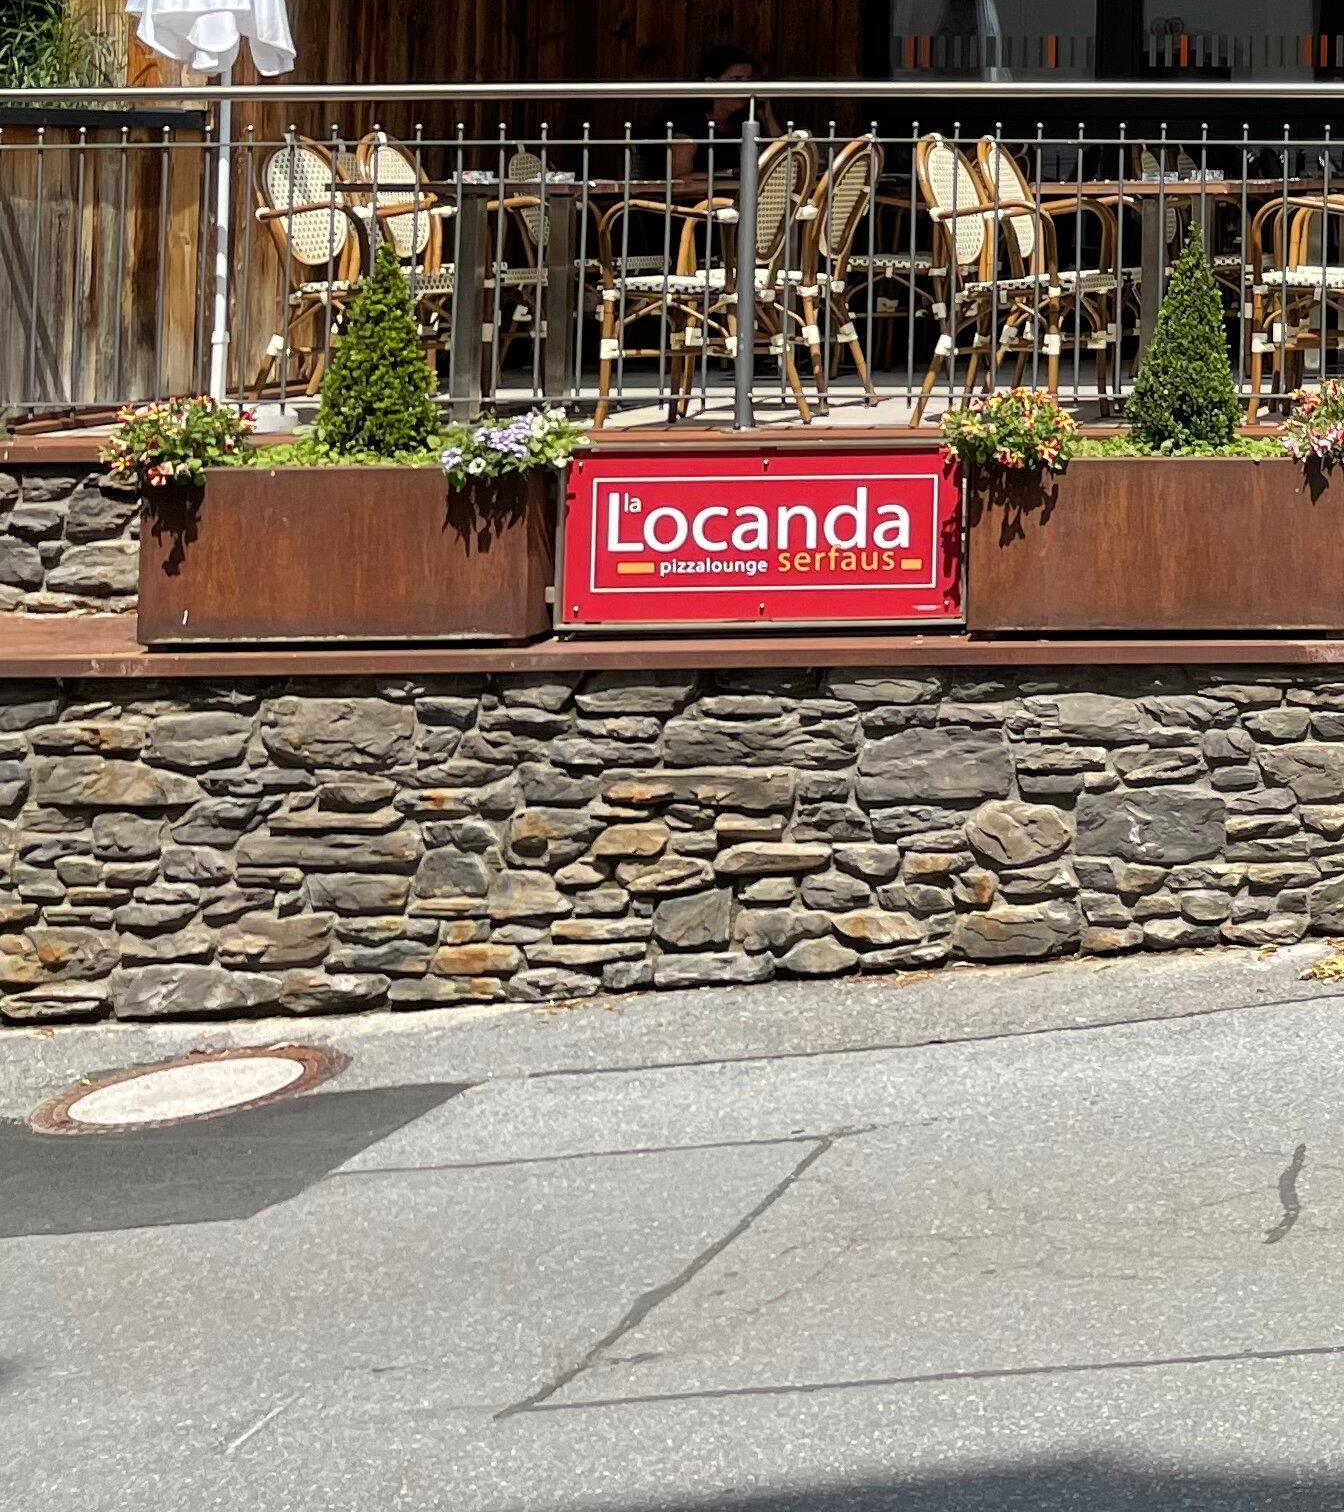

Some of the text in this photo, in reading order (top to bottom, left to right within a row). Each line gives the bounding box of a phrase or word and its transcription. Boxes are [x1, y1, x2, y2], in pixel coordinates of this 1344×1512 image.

[606, 485, 911, 553] la Locanda
[658, 543, 896, 577] pizzalounge serfaus
